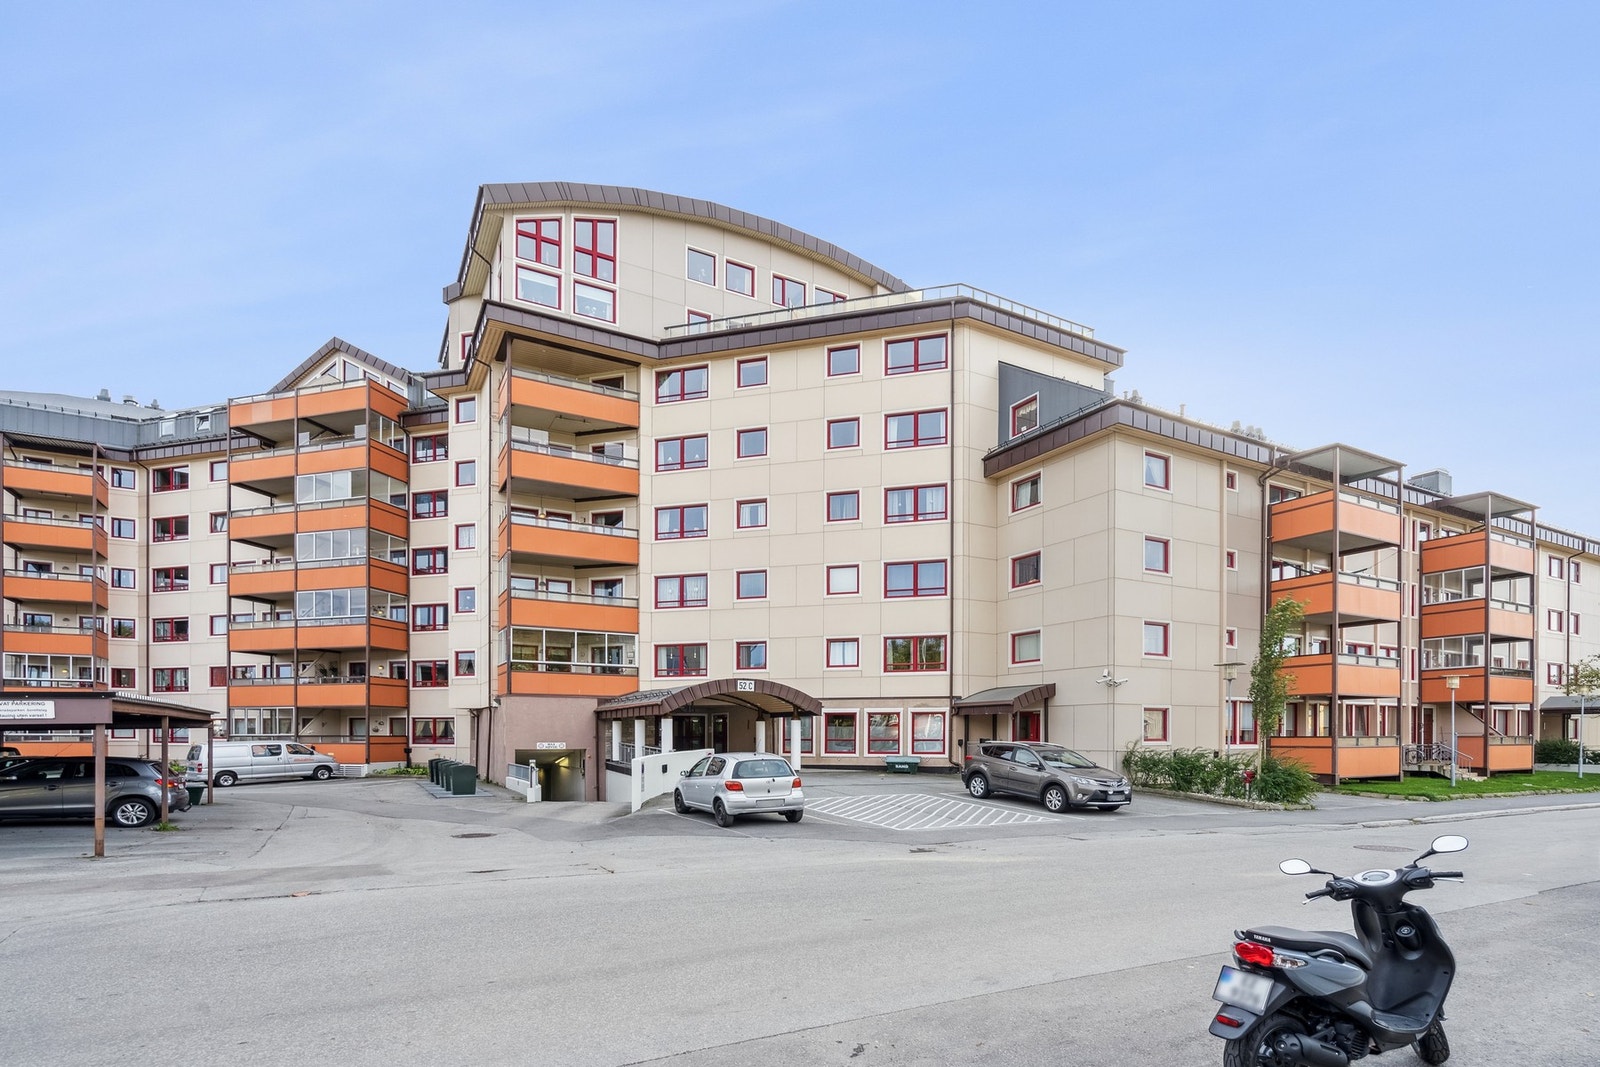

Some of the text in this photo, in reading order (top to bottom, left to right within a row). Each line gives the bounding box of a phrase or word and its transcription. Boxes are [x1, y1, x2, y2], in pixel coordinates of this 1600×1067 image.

[739, 681, 753, 690] 52 C
[1253, 934, 1271, 942] YAMAHA
